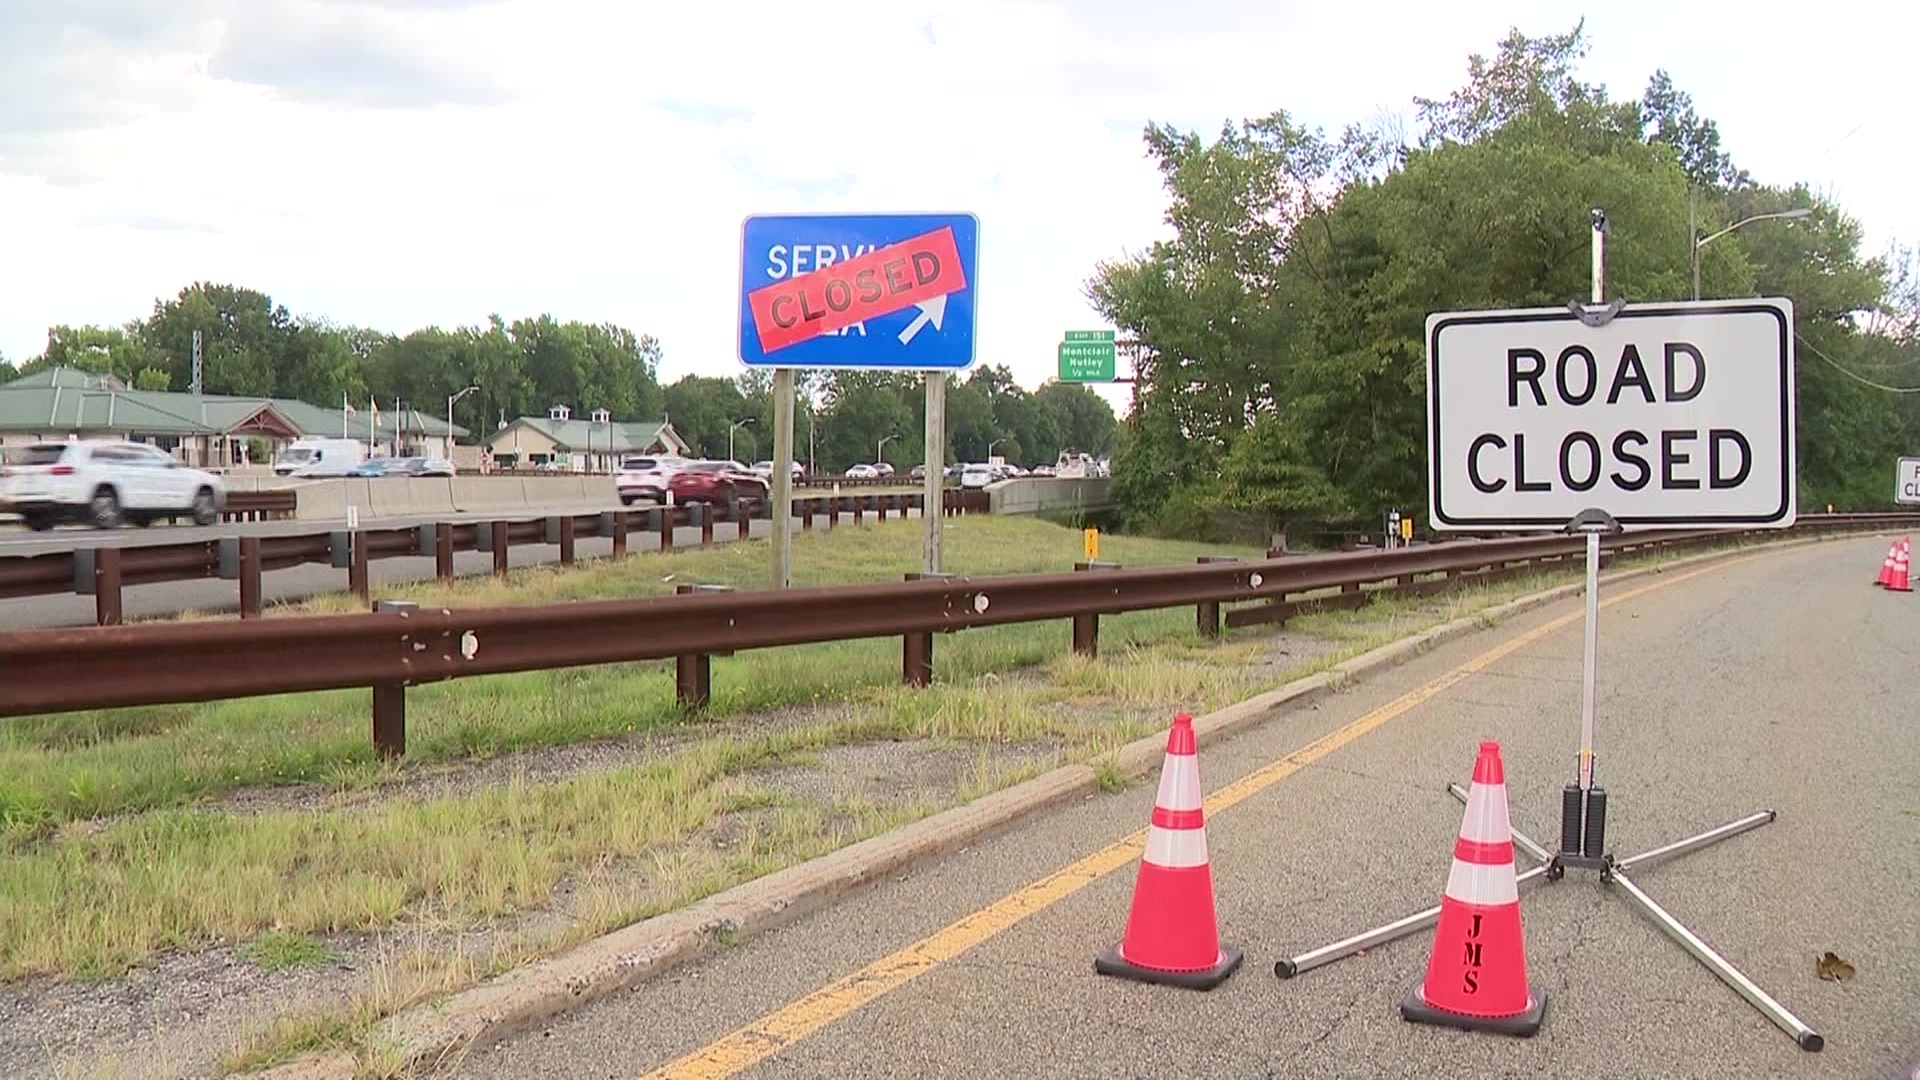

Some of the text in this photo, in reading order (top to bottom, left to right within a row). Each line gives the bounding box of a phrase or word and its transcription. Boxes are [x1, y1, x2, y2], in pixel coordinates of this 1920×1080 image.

[772, 251, 941, 329] CLOSED
[1063, 347, 1110, 356] Montclair
[1070, 358, 1103, 368] Nutley
[1507, 342, 1706, 407] ROAD
[1467, 429, 1752, 493] CLOSED
